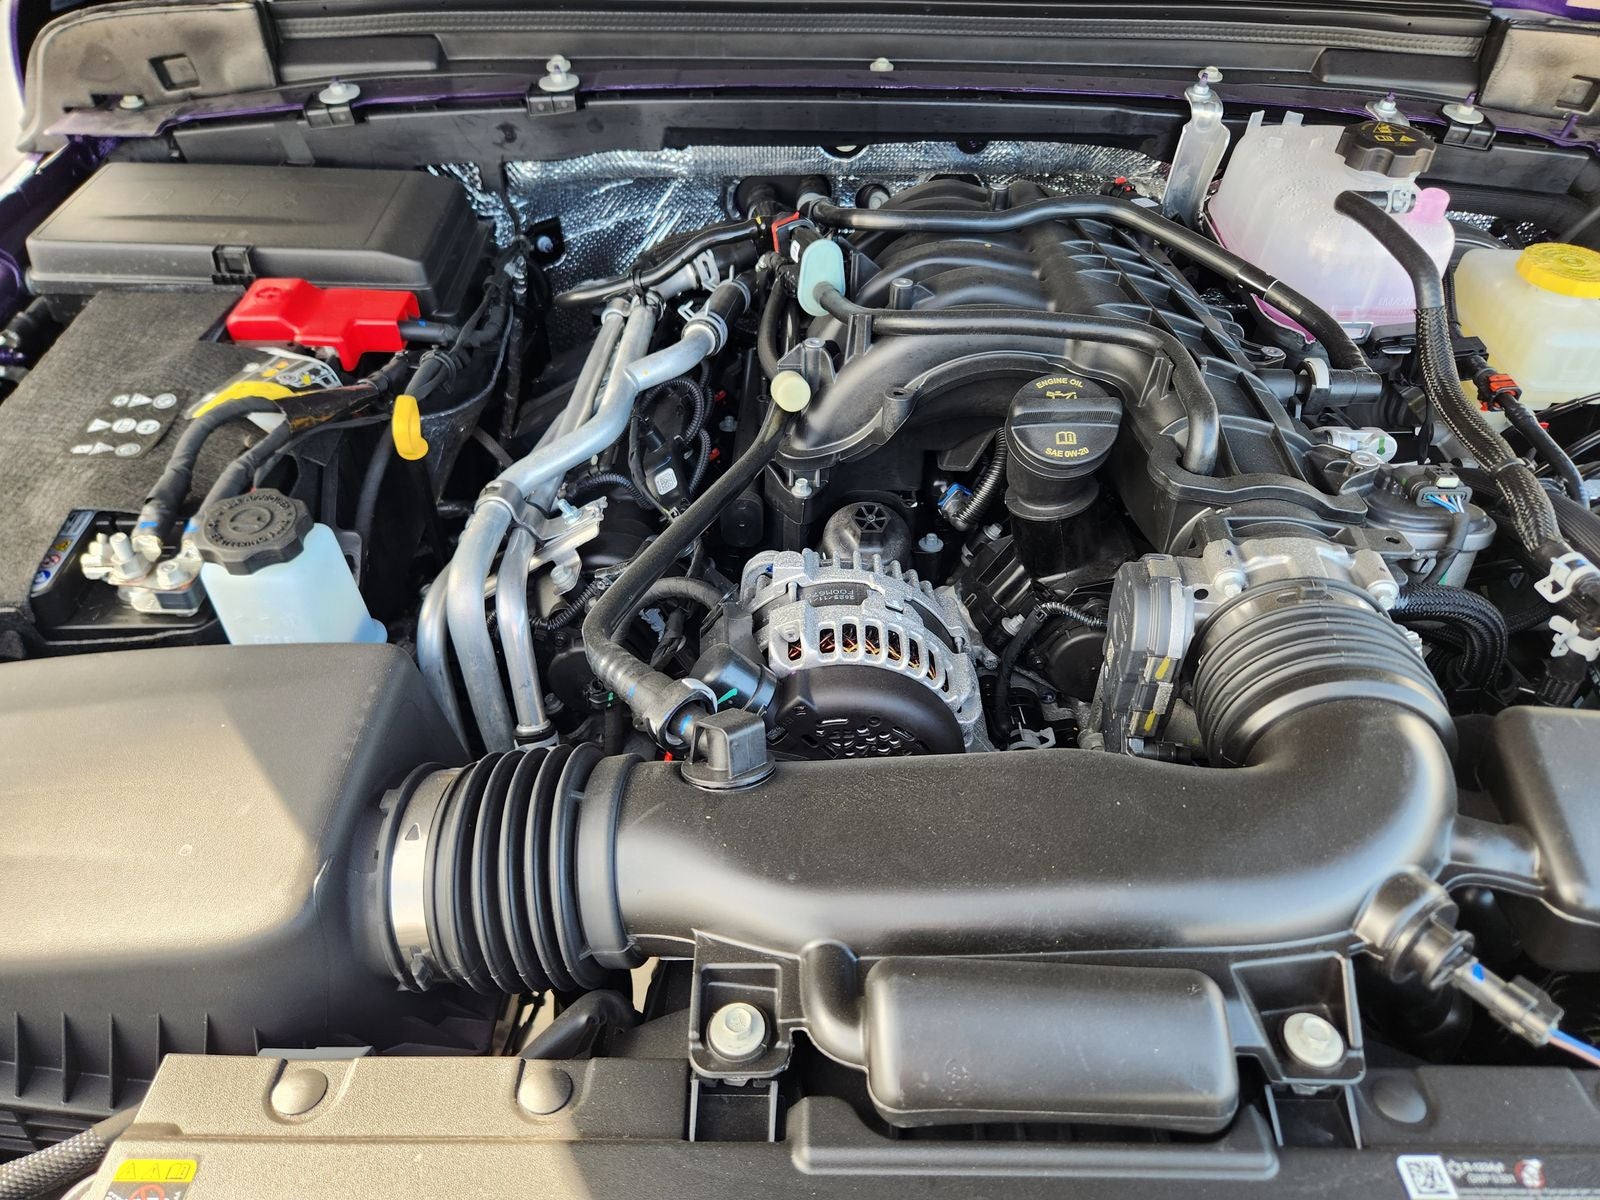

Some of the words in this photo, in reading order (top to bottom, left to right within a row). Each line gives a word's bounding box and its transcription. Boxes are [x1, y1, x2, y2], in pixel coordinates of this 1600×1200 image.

[1036, 378, 1068, 388] ENGINE
[1070, 379, 1083, 388] OIL
[1045, 447, 1063, 457] SAE
